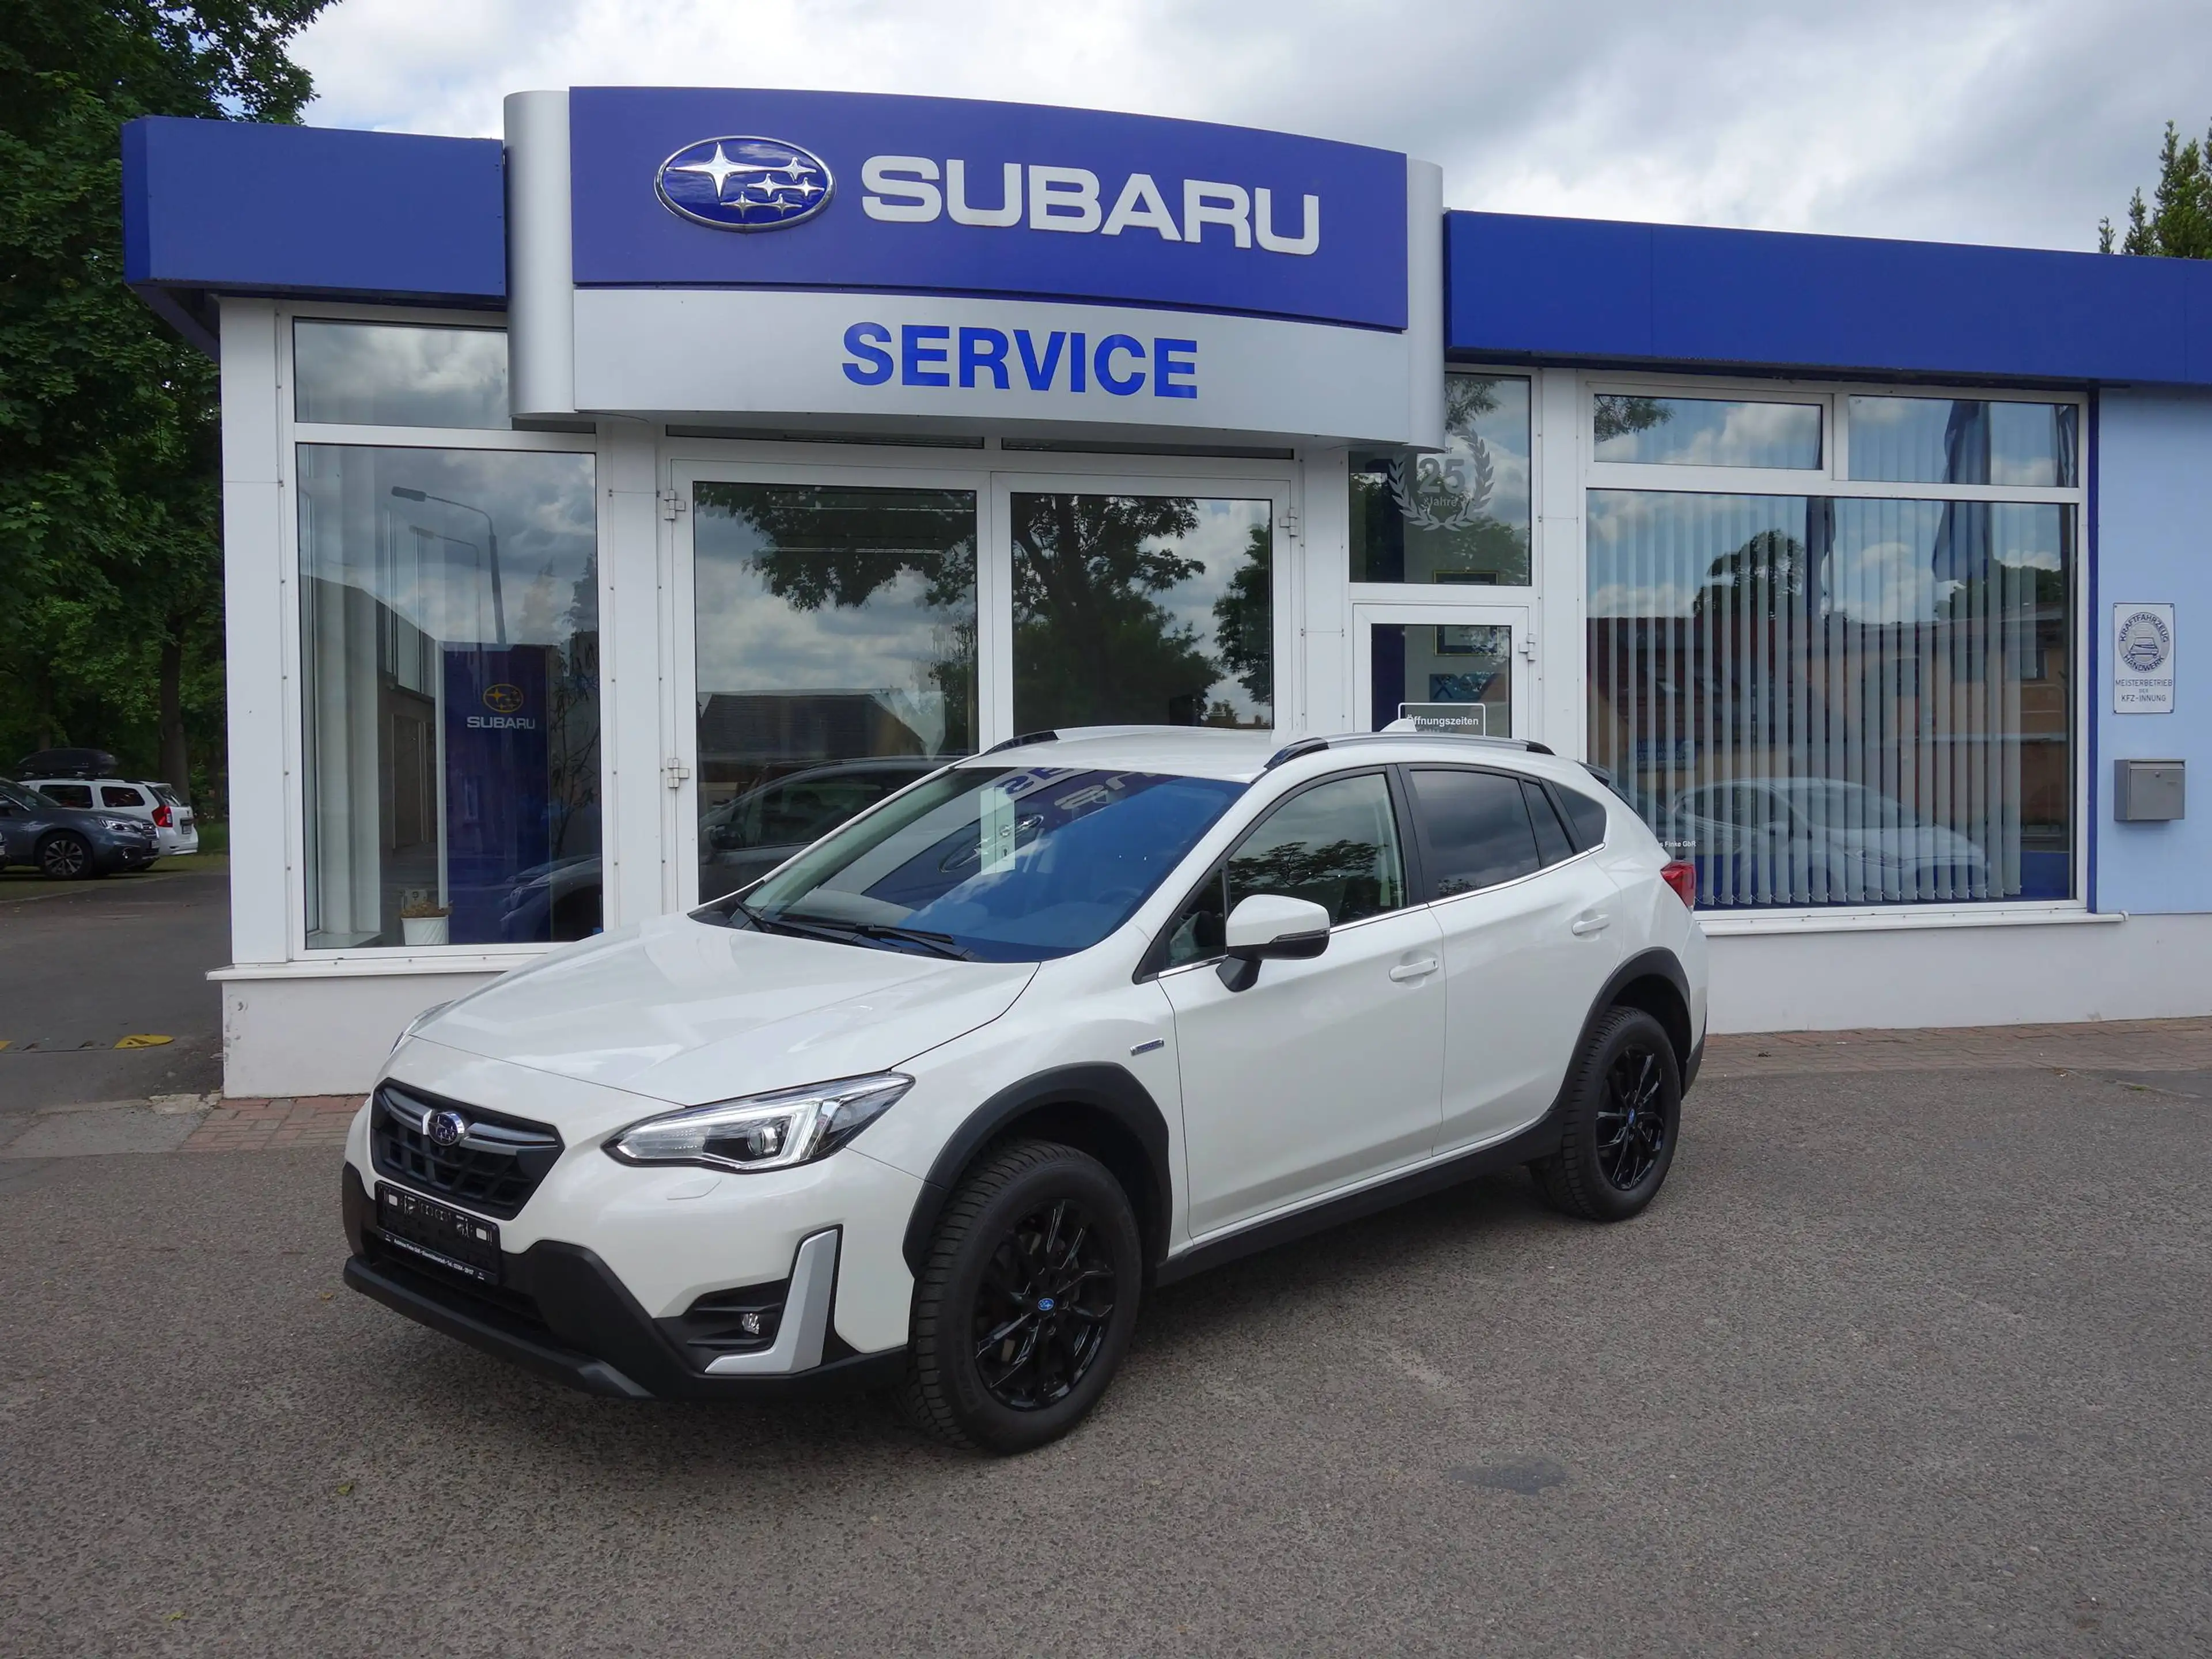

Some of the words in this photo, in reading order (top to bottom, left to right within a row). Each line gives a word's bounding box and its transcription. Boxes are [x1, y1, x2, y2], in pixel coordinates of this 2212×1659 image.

[862, 155, 1320, 256] SUBARU
[842, 321, 1198, 399] SERVICE
[1418, 457, 1465, 495] 25
[2120, 613, 2169, 642] KRAFTFAHRZEUG
[2123, 654, 2164, 672] HANDWERK
[2121, 694, 2166, 702] KFZ-INNUNG
[467, 716, 535, 730] SUBARU
